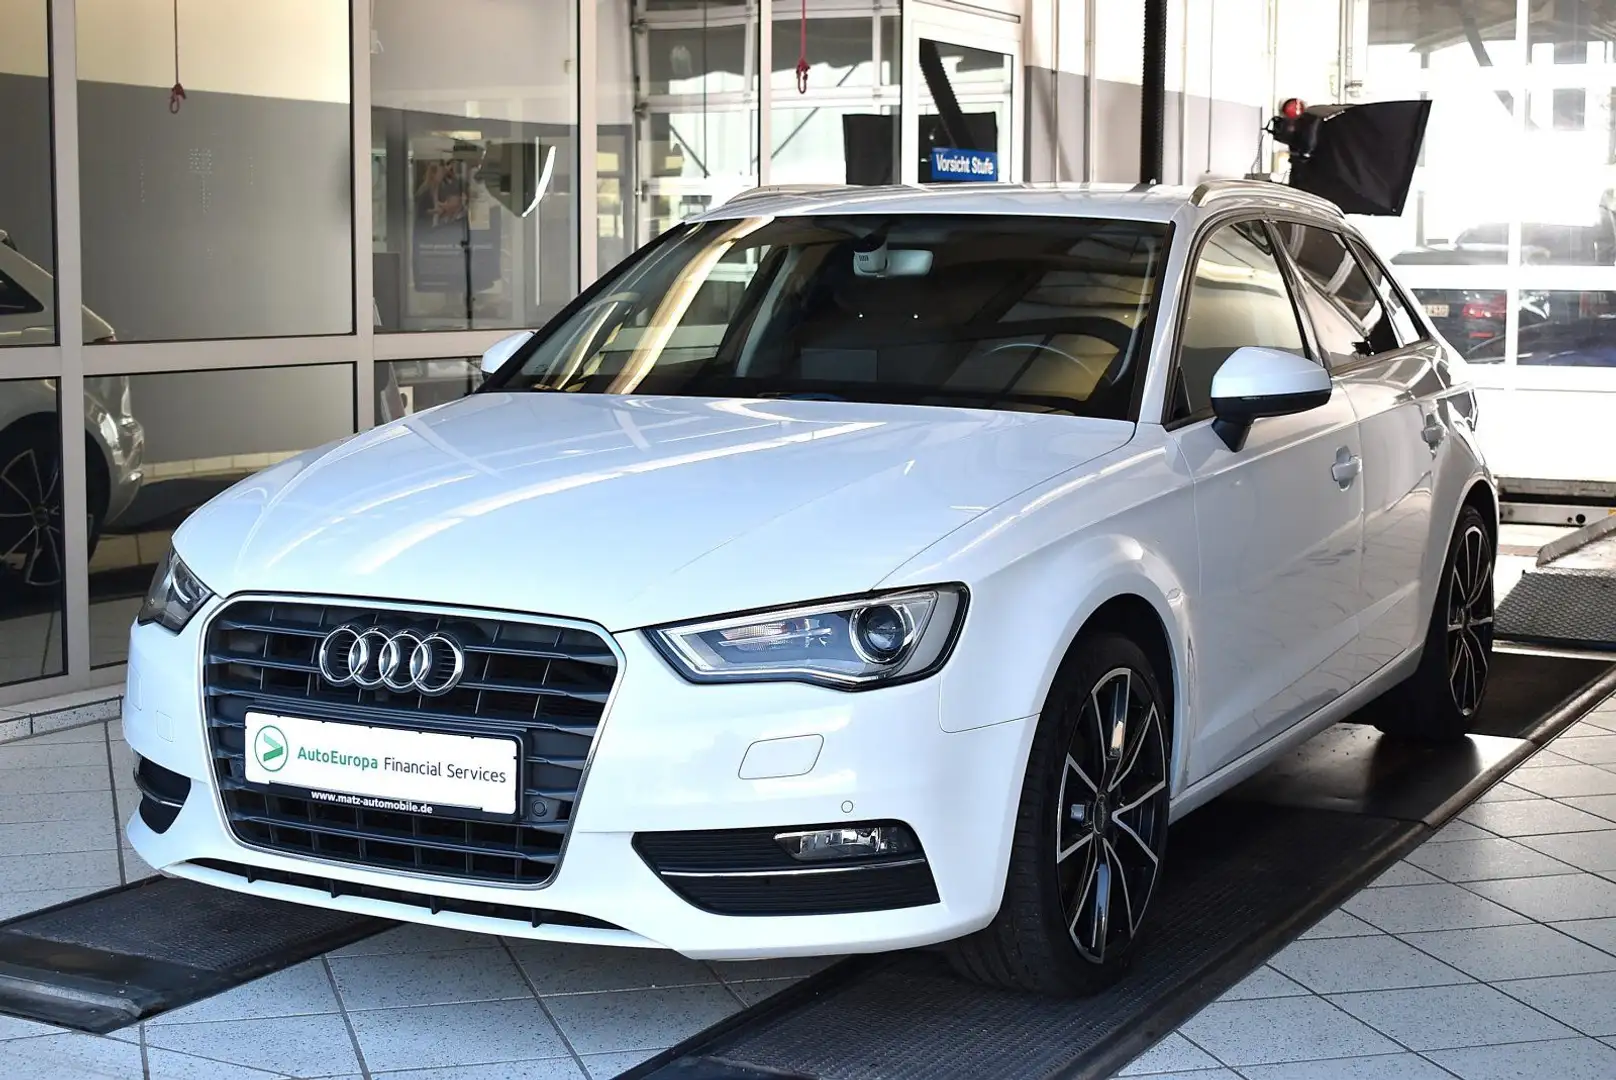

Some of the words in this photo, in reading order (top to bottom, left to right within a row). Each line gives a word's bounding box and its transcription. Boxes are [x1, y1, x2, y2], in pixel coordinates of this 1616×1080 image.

[935, 152, 970, 174] Vorsicht
[971, 156, 994, 175] Stufe
[297, 746, 378, 771] AutoEuropa
[384, 757, 442, 777] Financial
[446, 763, 507, 783] Services
[310, 790, 433, 814] www.matz-automobile.de
